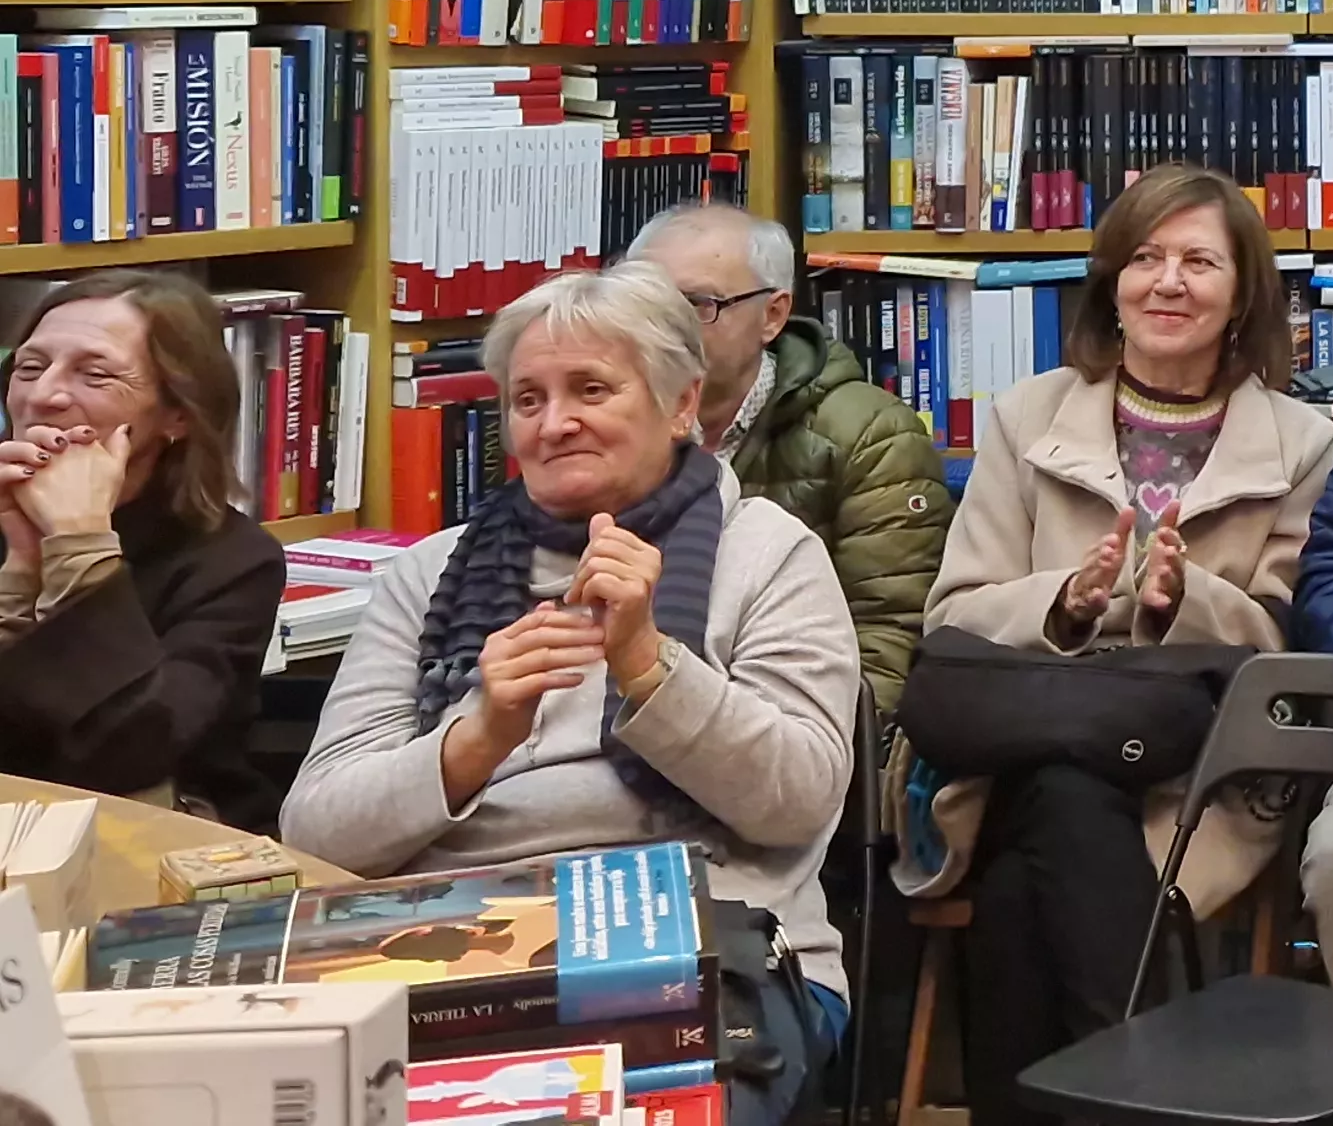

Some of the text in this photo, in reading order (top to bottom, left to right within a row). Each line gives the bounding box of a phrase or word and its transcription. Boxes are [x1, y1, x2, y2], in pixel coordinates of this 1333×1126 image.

[151, 71, 171, 124] Franco
[185, 65, 215, 169] MISIÓN
[226, 134, 243, 190] Nexus
[1317, 321, 1330, 369] LA SICIL
[285, 410, 302, 442] REY
[190, 937, 220, 970] COSAS
[470, 996, 558, 1017] onnolly LA
